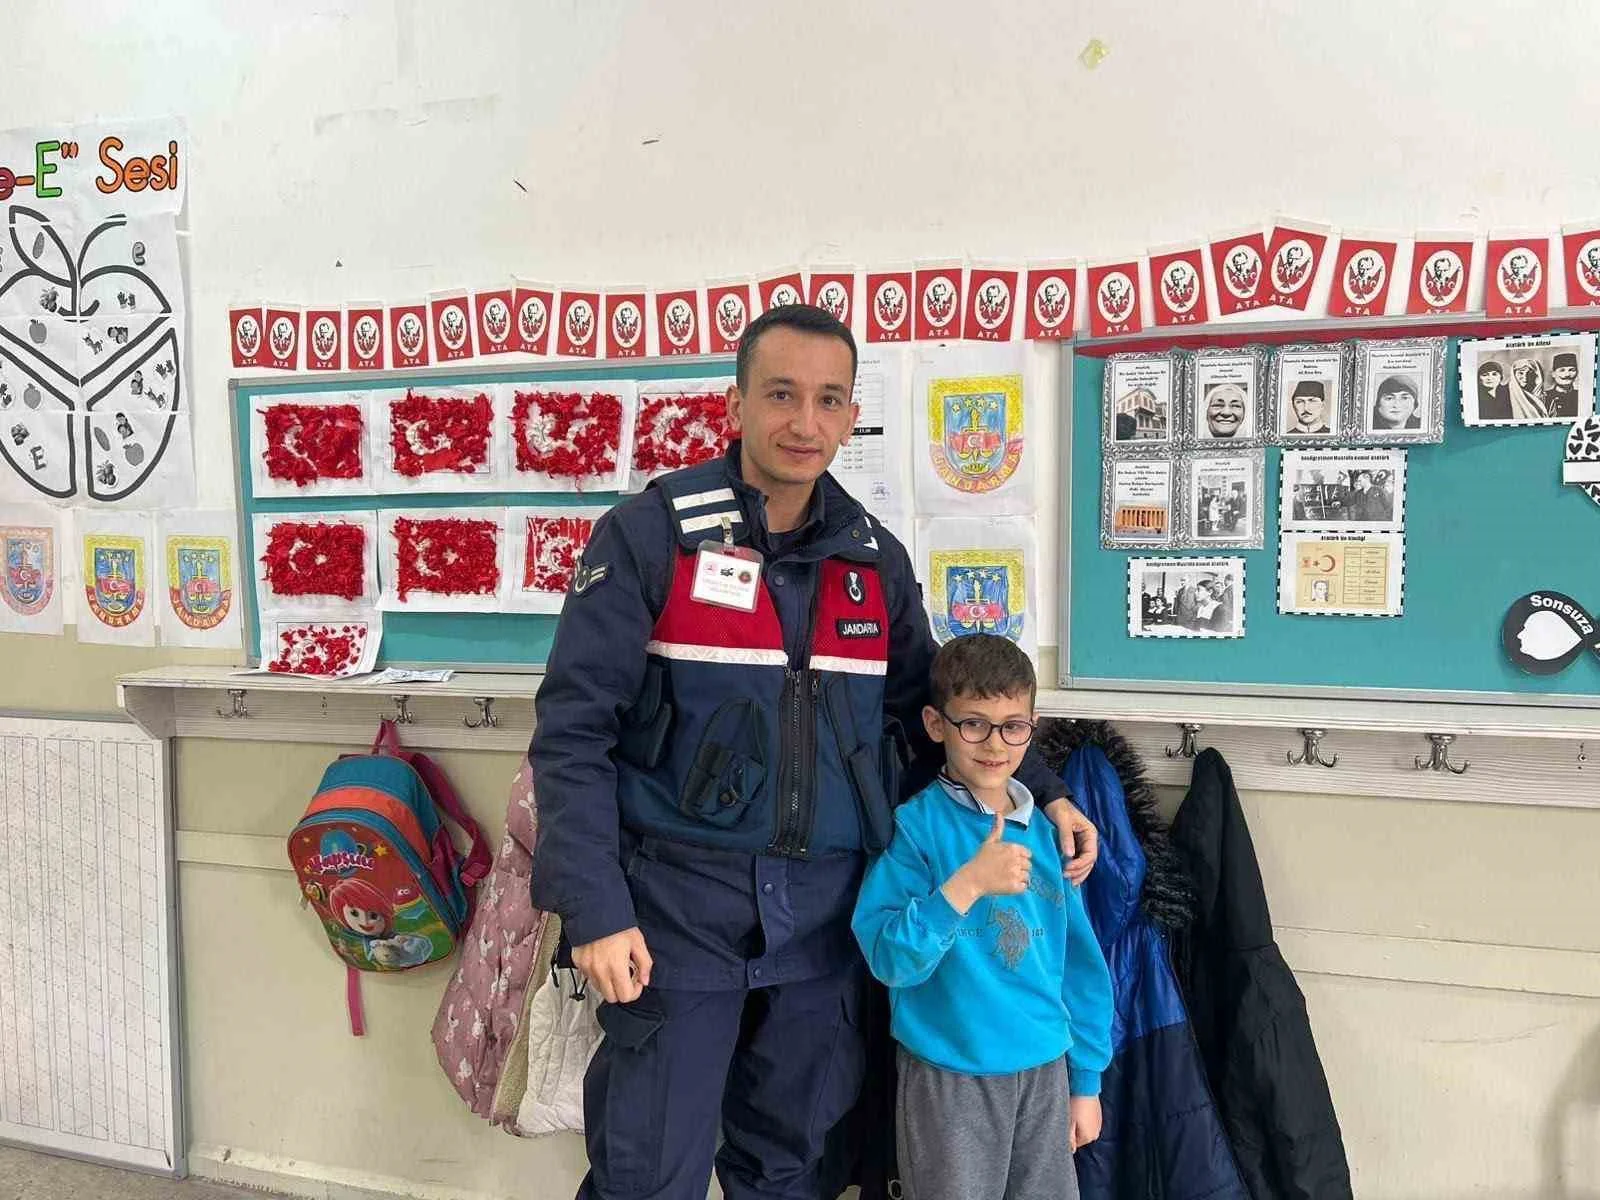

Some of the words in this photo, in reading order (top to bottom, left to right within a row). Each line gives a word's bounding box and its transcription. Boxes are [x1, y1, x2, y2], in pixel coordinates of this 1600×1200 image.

[96, 136, 178, 194] Sesi
[1269, 295, 1293, 305] ATA
[1236, 301, 1259, 309] ATA
[1345, 307, 1369, 316] ATA
[1505, 306, 1531, 314] ATA
[1172, 314, 1195, 324] ATA
[1107, 325, 1129, 334] ATA
[569, 346, 586, 355] ATA
[30, 446, 46, 470] E
[1530, 594, 1593, 634] Sonsuza
